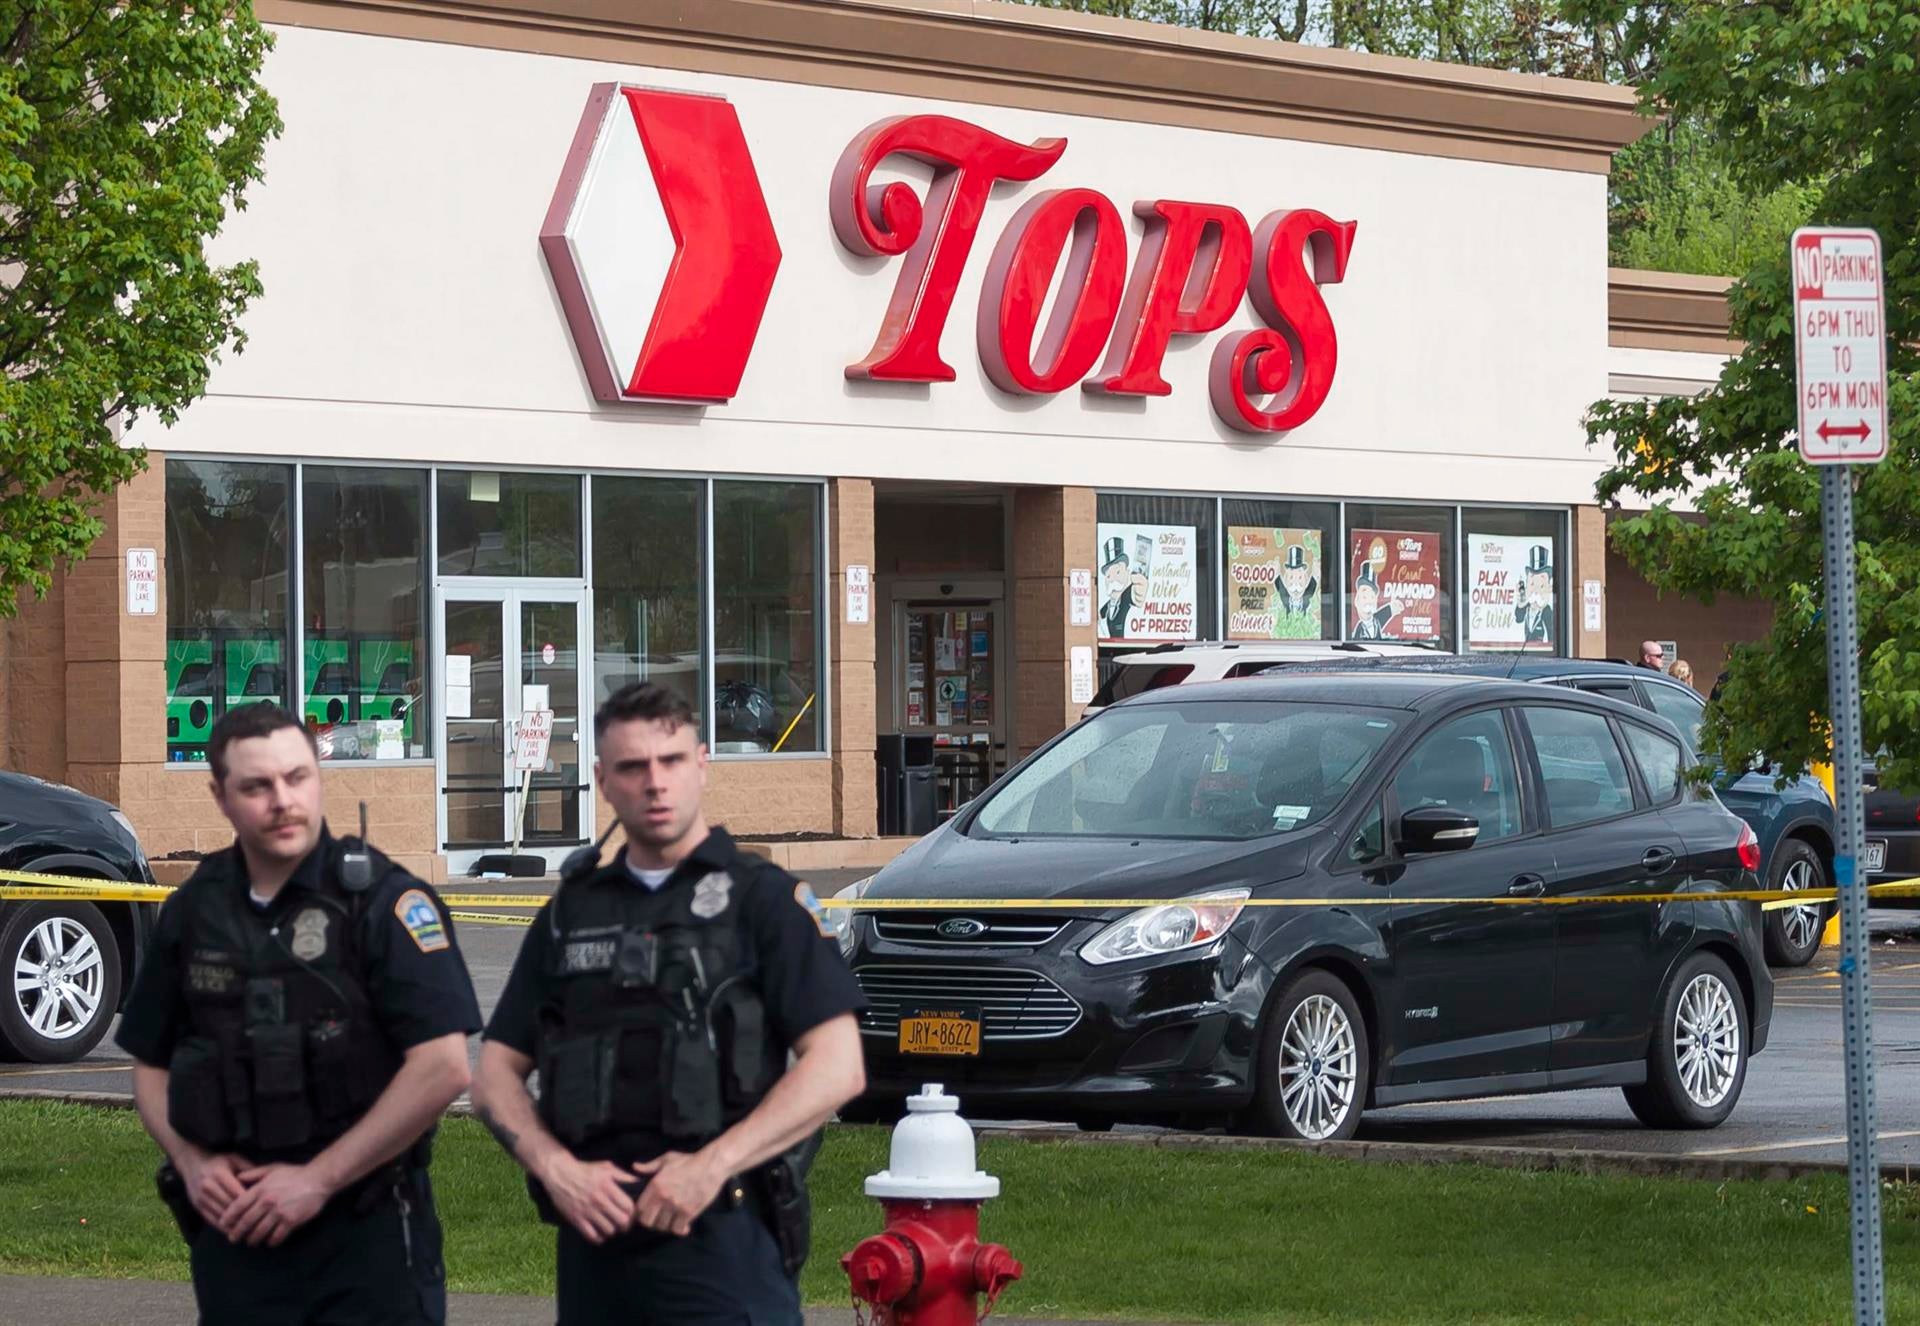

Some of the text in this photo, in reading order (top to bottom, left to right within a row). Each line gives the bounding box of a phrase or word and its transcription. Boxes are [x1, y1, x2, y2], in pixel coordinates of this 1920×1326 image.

[1798, 247, 1876, 290] NO PARKING
[1807, 310, 1875, 338] 6PM THU
[1832, 346, 1852, 373] TO
[1807, 382, 1880, 409] 6PM MON
[136, 555, 148, 568] NO
[130, 569, 156, 582] PARKING
[1232, 564, 1275, 583] $60,000
[1478, 570, 1508, 586] PLAY
[135, 592, 150, 601] LANE
[1238, 586, 1267, 598] GRAND
[1383, 582, 1436, 600] DIAMOND
[1472, 589, 1514, 605] ONLINE
[1144, 602, 1192, 616] MILLIONS
[1240, 599, 1265, 610] PRIZE
[1131, 619, 1193, 634] OF PRIZES!
[530, 714, 543, 728] NO
[521, 728, 549, 740] PARKING
[945, 920, 973, 935] Ford
